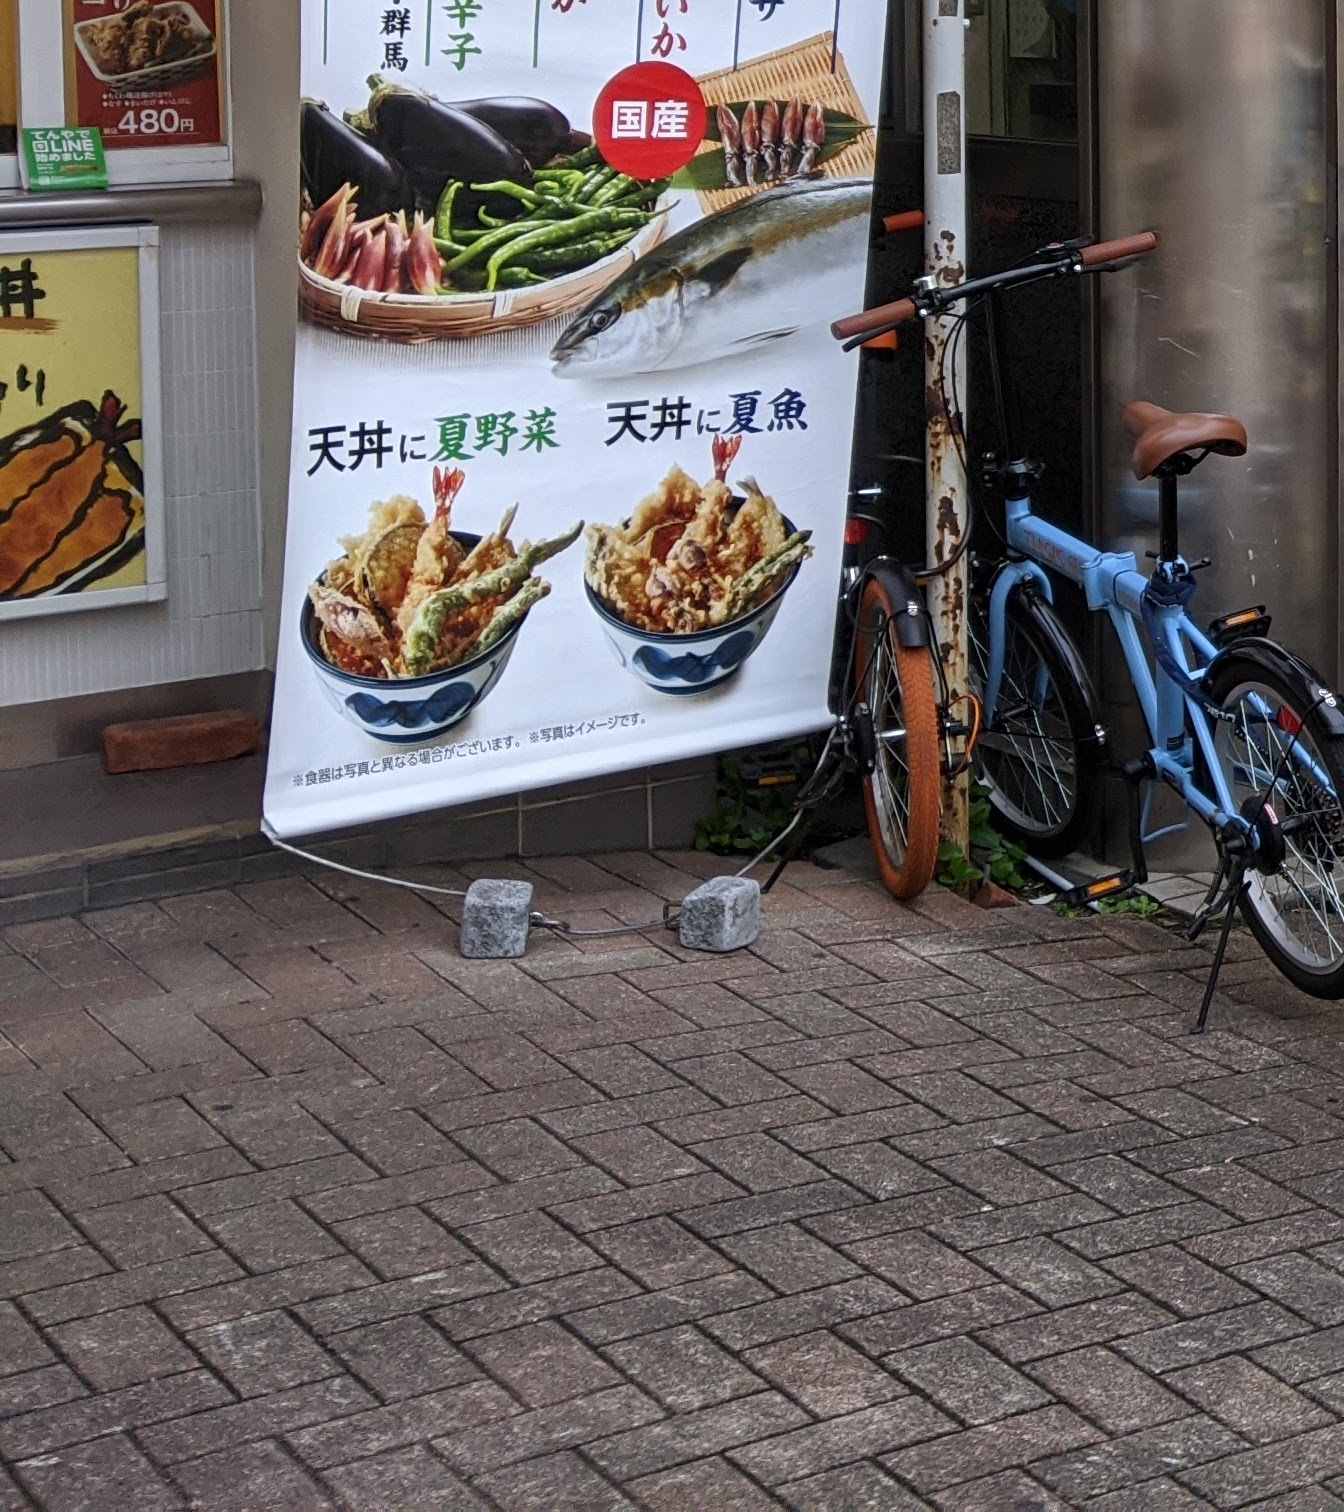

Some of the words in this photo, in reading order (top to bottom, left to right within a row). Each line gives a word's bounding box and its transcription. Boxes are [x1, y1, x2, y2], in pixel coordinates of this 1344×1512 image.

[30, 130, 90, 140] てんやで
[118, 108, 194, 135] 480円
[611, 99, 689, 139] 国産
[50, 139, 95, 152] LINE
[603, 387, 809, 447] 天丼に夏魚
[306, 406, 562, 477] 天丼に夏野菜
